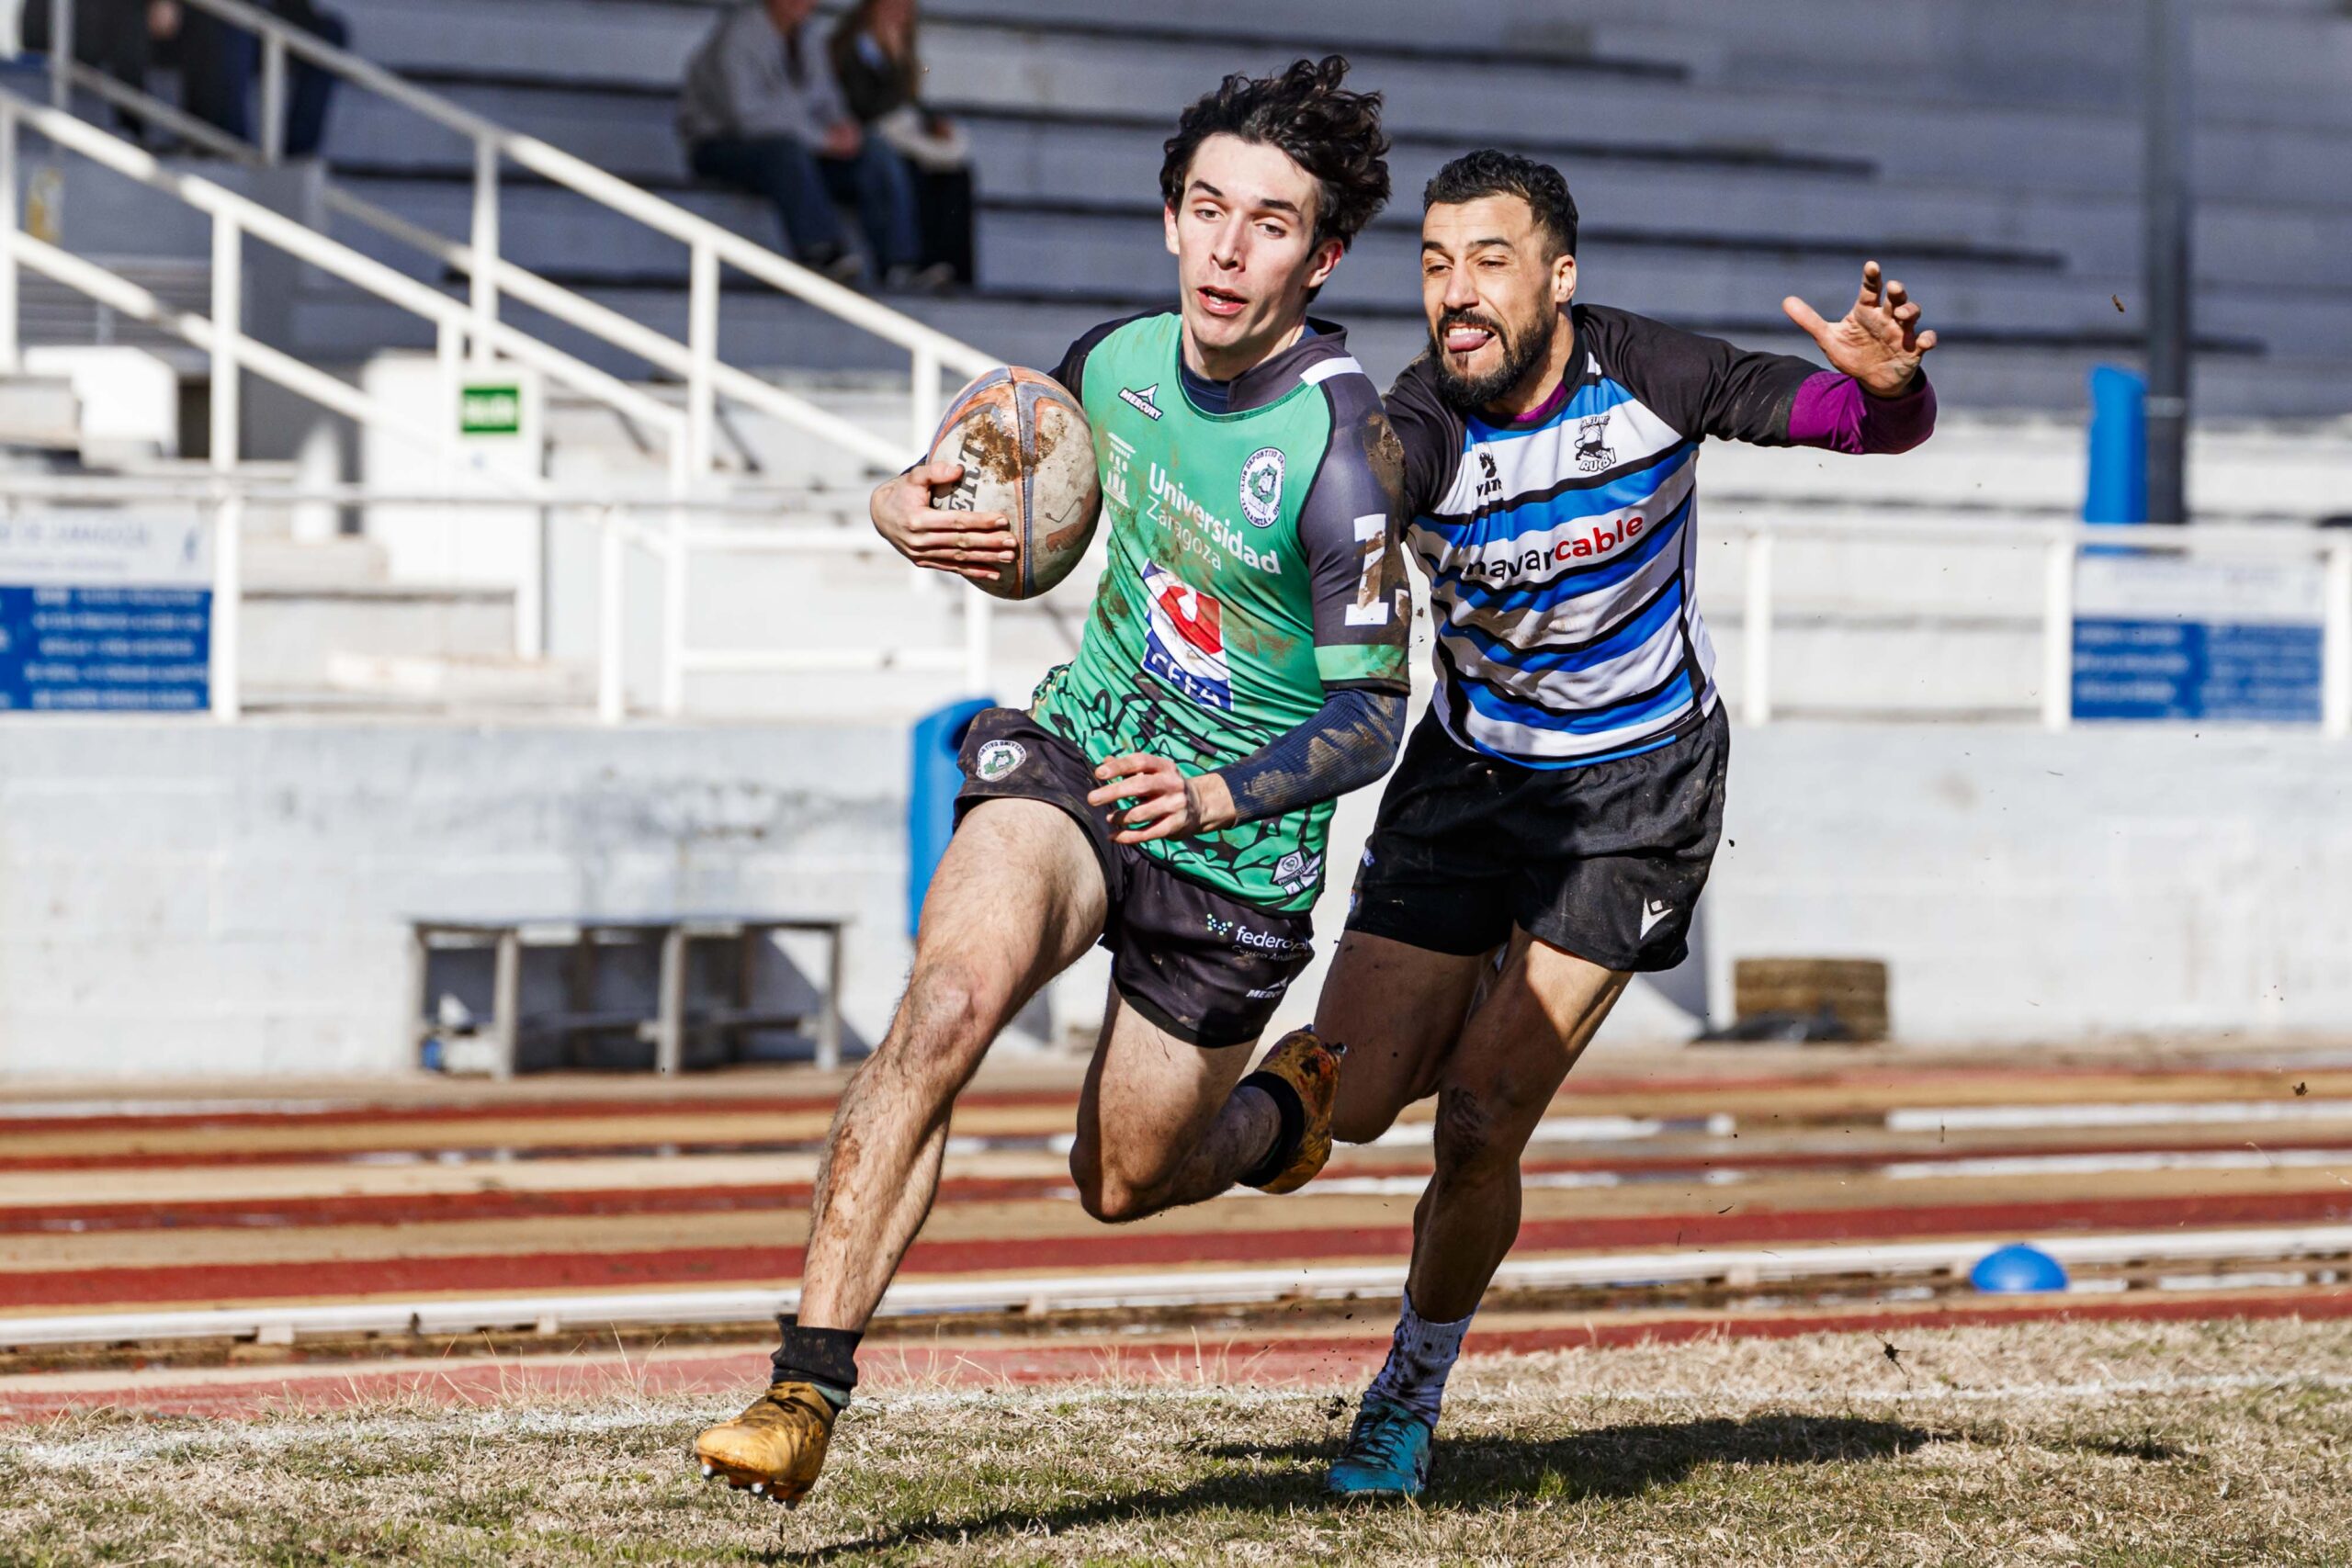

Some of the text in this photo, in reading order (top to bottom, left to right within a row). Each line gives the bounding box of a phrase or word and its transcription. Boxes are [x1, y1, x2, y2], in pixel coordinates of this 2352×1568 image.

[1120, 389, 1162, 420] MERCURY
[1147, 494, 1221, 571] Zaragoza
[1149, 462, 1282, 574] Universidad
[1466, 516, 1643, 581] navarcable
